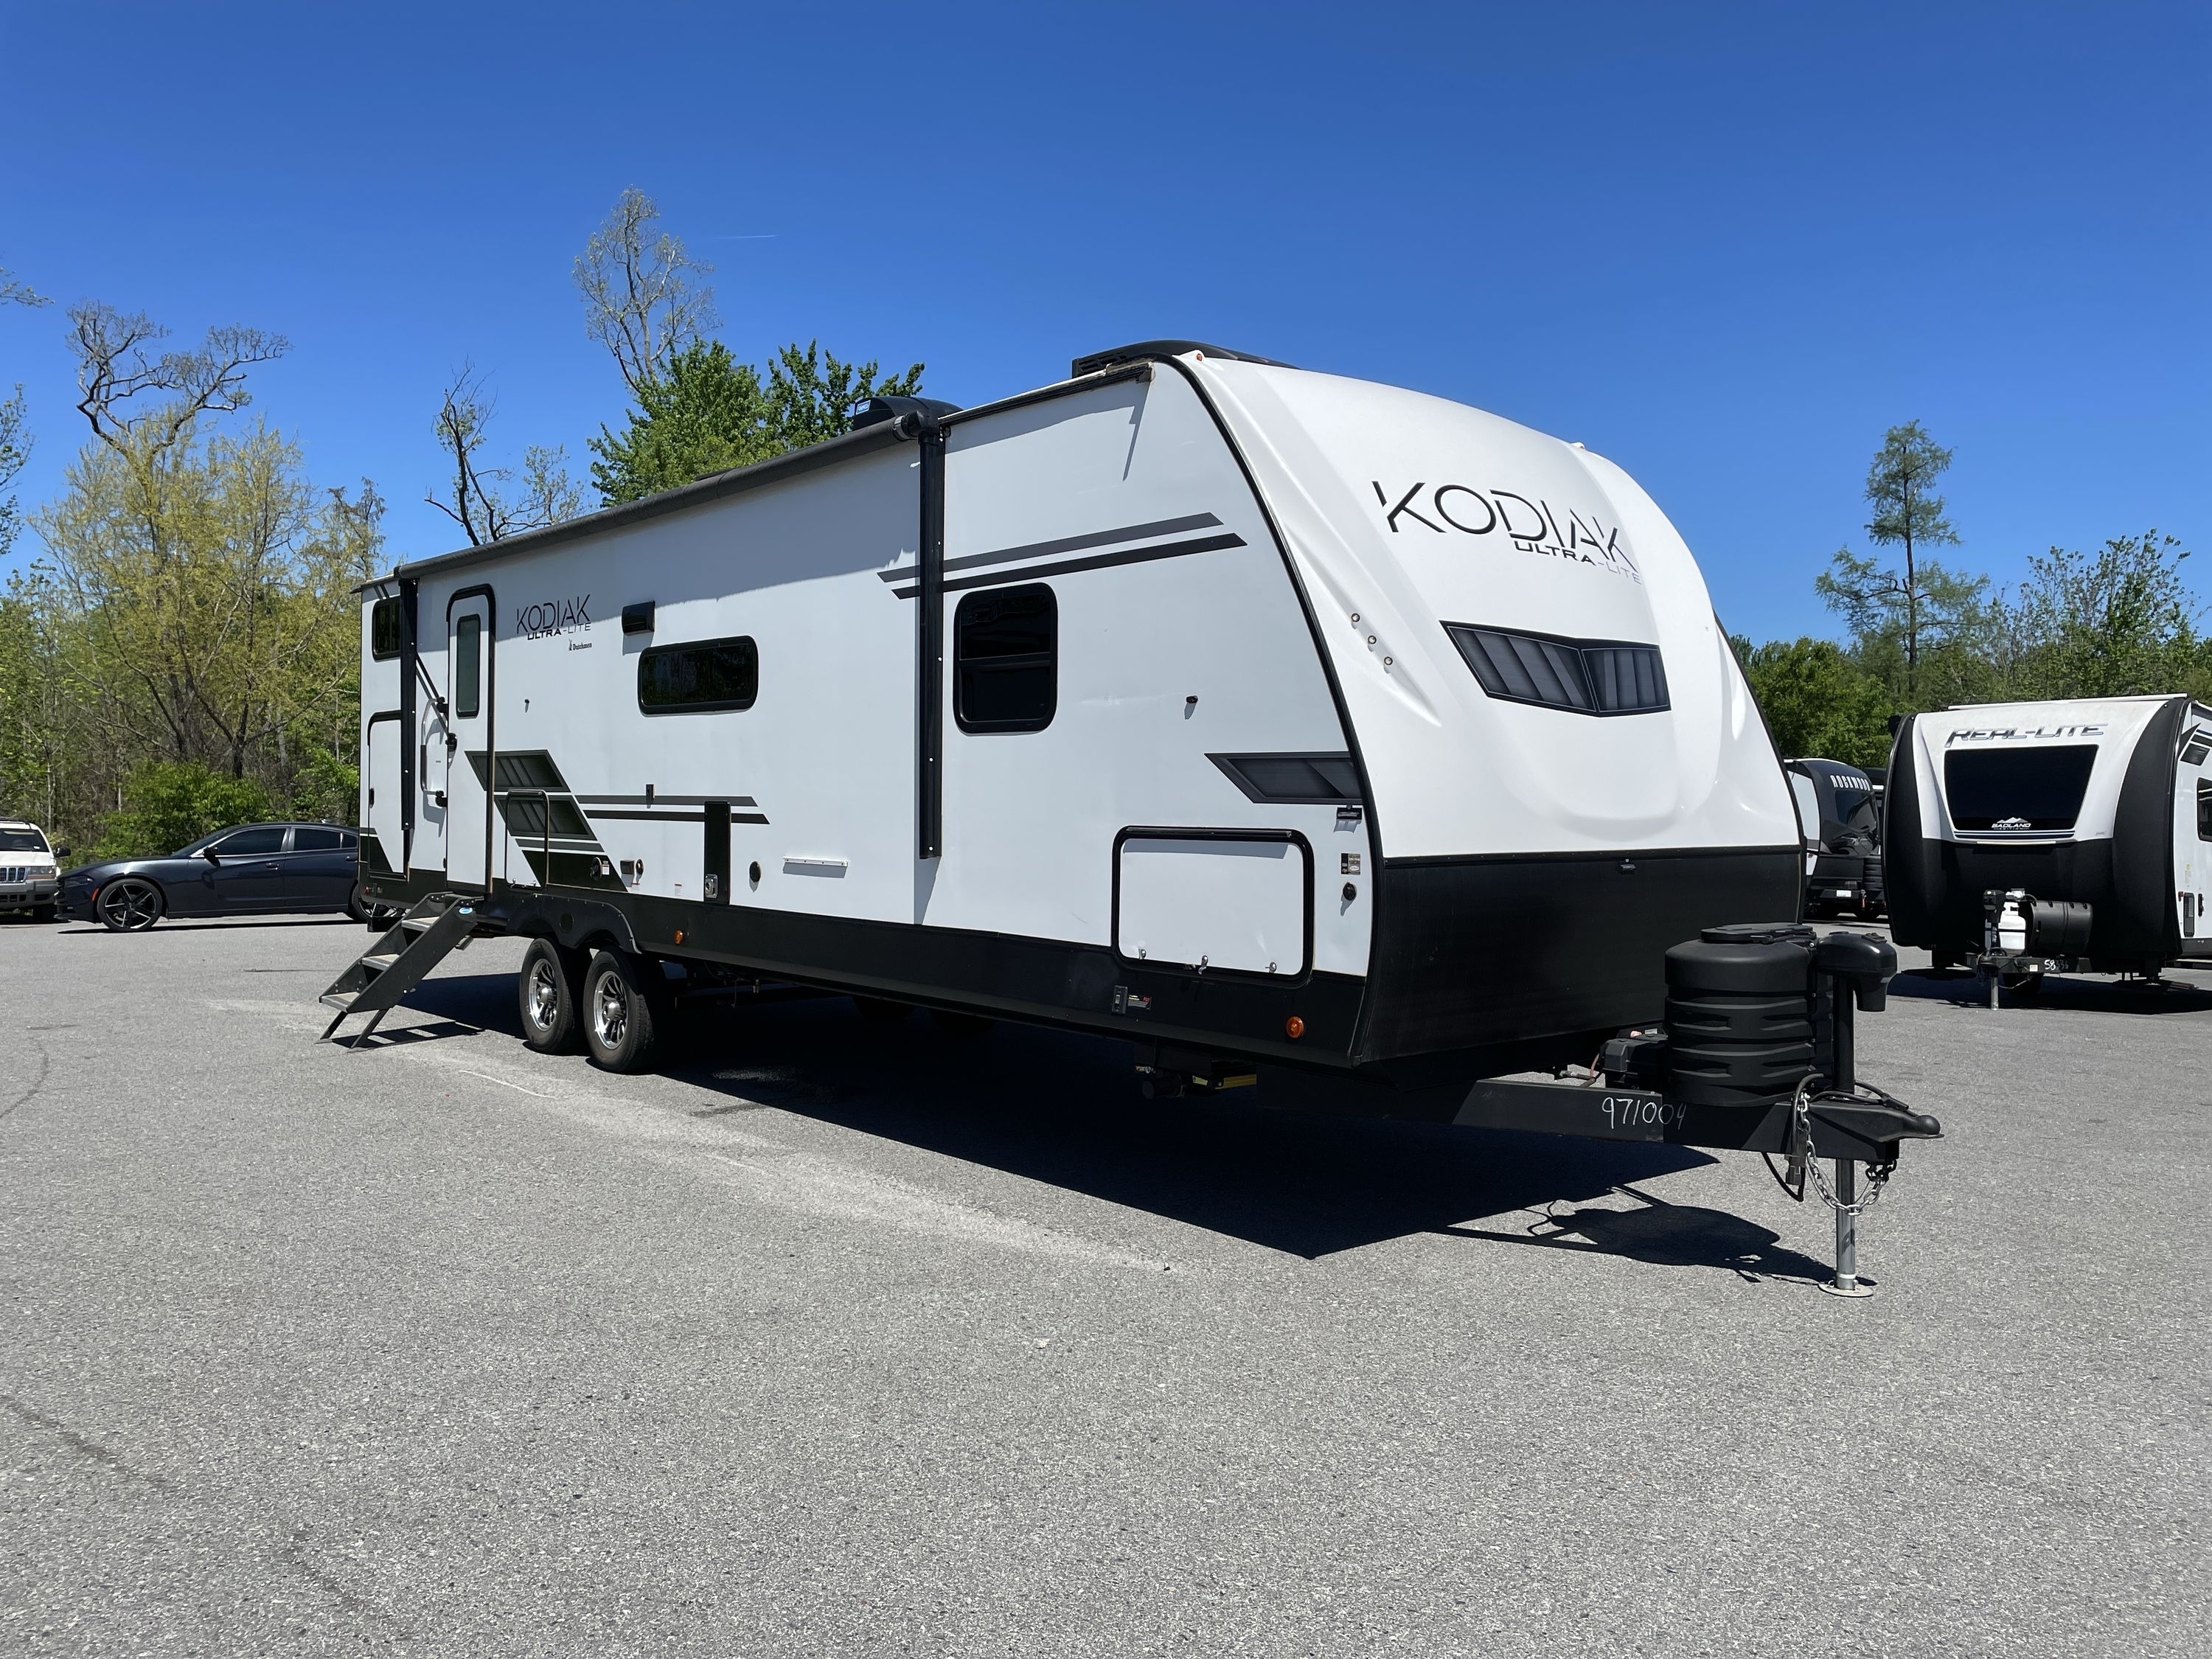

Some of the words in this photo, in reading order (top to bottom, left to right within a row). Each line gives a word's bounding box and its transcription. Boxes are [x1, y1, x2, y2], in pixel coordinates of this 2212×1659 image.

[1371, 480, 1638, 572] KODIAK
[1514, 540, 1642, 585] ULTRA-LITE
[517, 594, 591, 634] KODIAK
[527, 622, 591, 641] ULTRA-LITE
[572, 642, 592, 650] Dutchmen
[1944, 723, 2108, 748] REAL-LITE
[1829, 774, 1871, 791] ROCKWOOD
[1601, 1096, 1687, 1130] 971004
